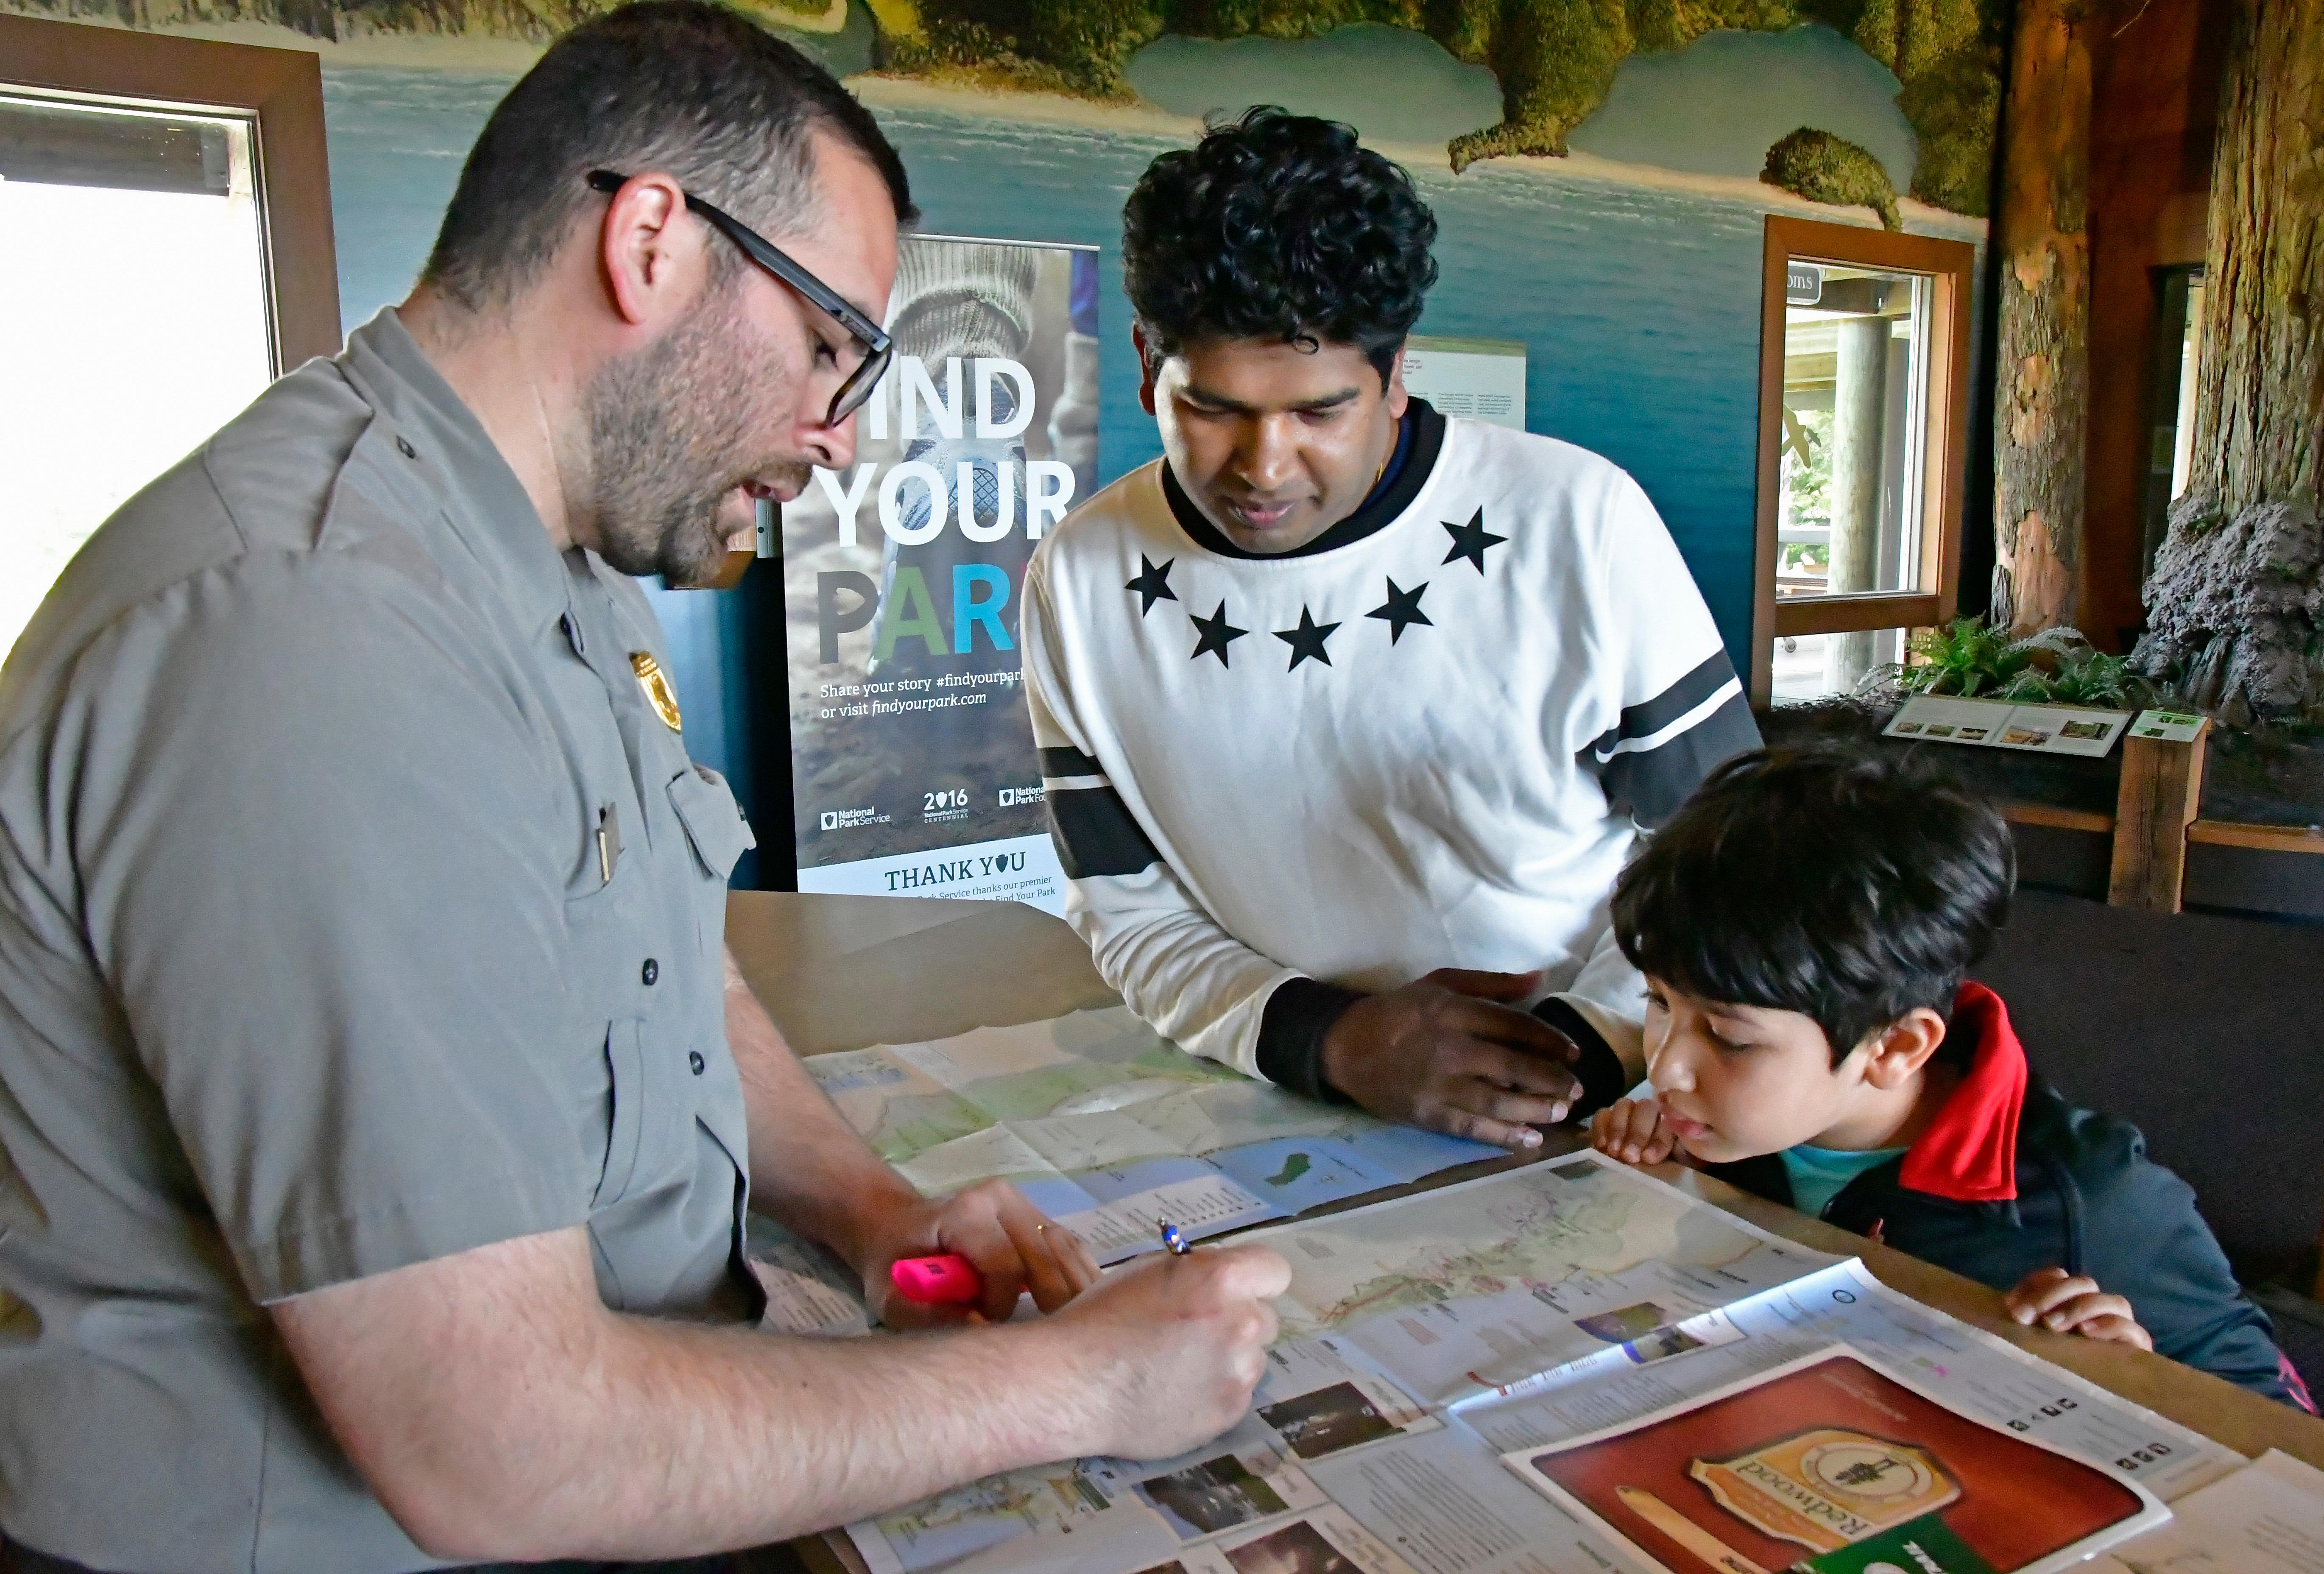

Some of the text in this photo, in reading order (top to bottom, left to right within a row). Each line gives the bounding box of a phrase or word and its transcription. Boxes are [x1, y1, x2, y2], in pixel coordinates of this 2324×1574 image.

[1788, 275, 1813, 290] oms
[869, 357, 1035, 439] IND
[813, 461, 1076, 547] YOUR
[817, 561, 1028, 664] PAR
[820, 684, 859, 698] Share
[862, 683, 894, 697] your
[898, 679, 932, 692] story
[822, 693, 987, 719] or visit findyourpark.com
[1016, 787, 1045, 796] Nationa
[839, 806, 874, 819] National
[924, 813, 968, 823] CENTENNIAL
[885, 860, 974, 891] THANK
[939, 876, 1052, 899] Service thanks our premier
[1017, 891, 1035, 900] Your
[1038, 887, 1055, 896] Park
[1737, 1462, 1867, 1535] Redwood
